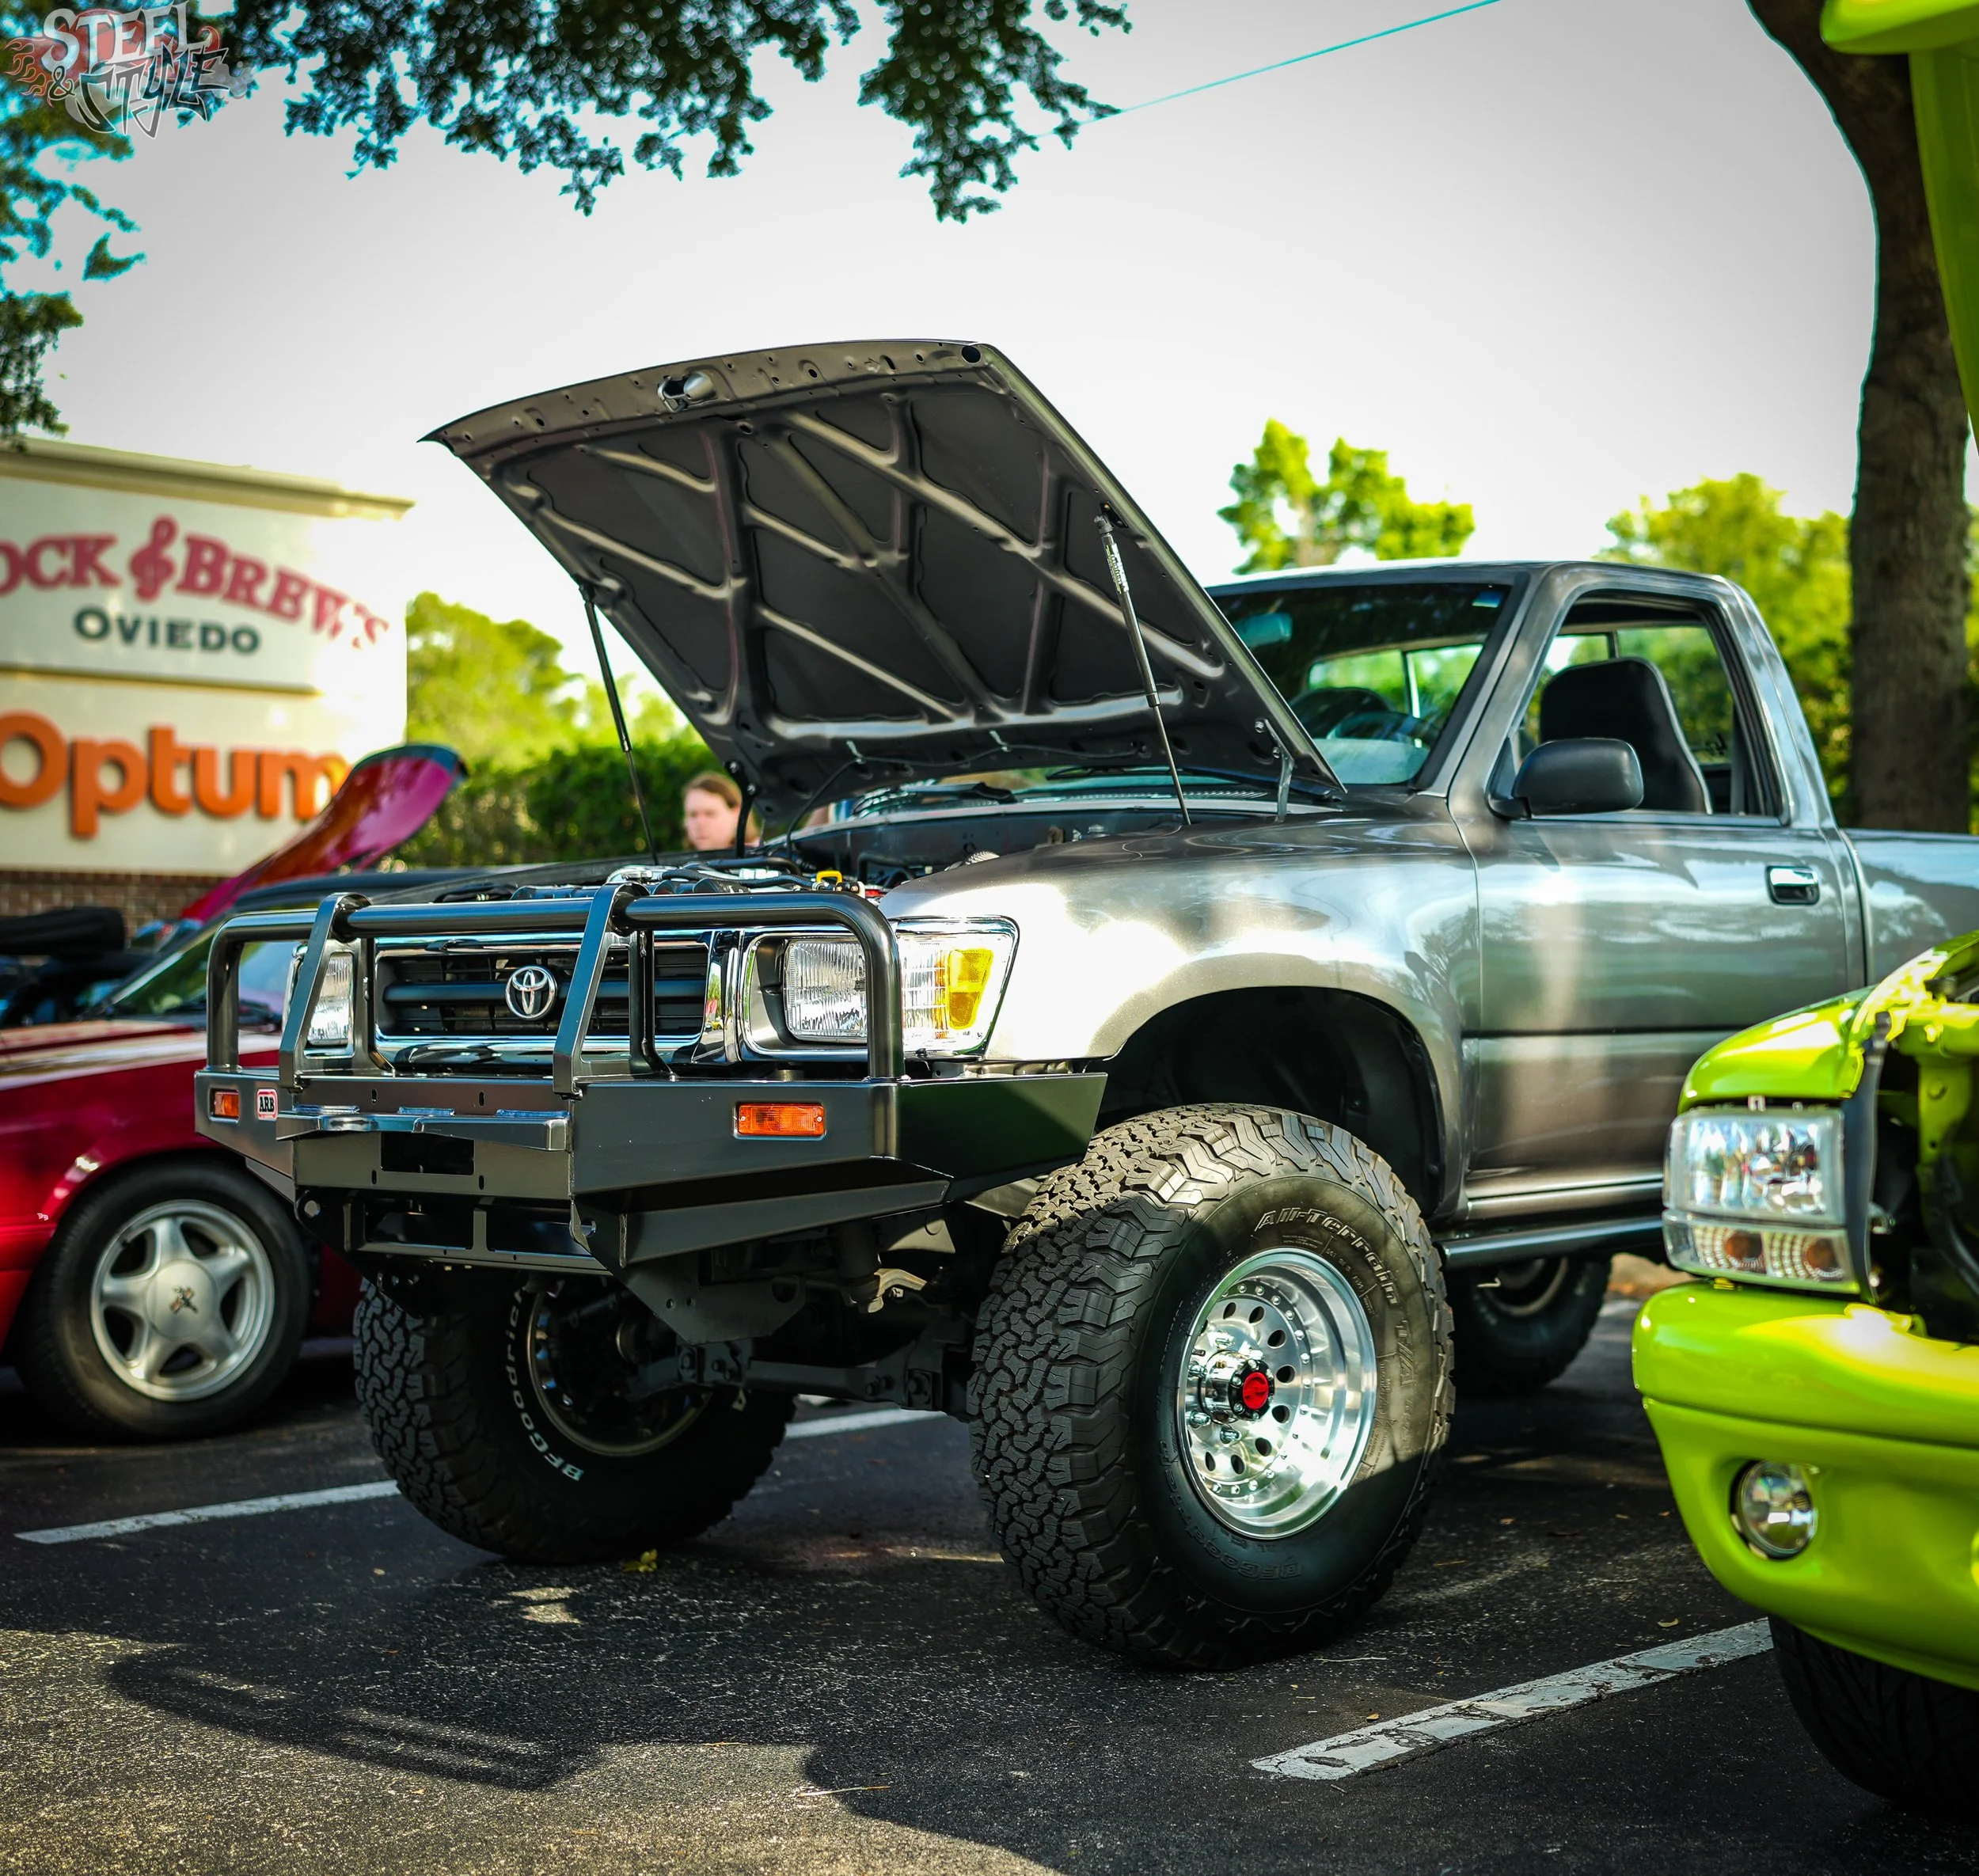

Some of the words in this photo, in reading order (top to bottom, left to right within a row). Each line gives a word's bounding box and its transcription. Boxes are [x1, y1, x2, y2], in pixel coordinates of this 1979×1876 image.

[72, 604, 261, 656] OVIEDO
[0, 709, 351, 841] Optum
[259, 1096, 275, 1113] ARB
